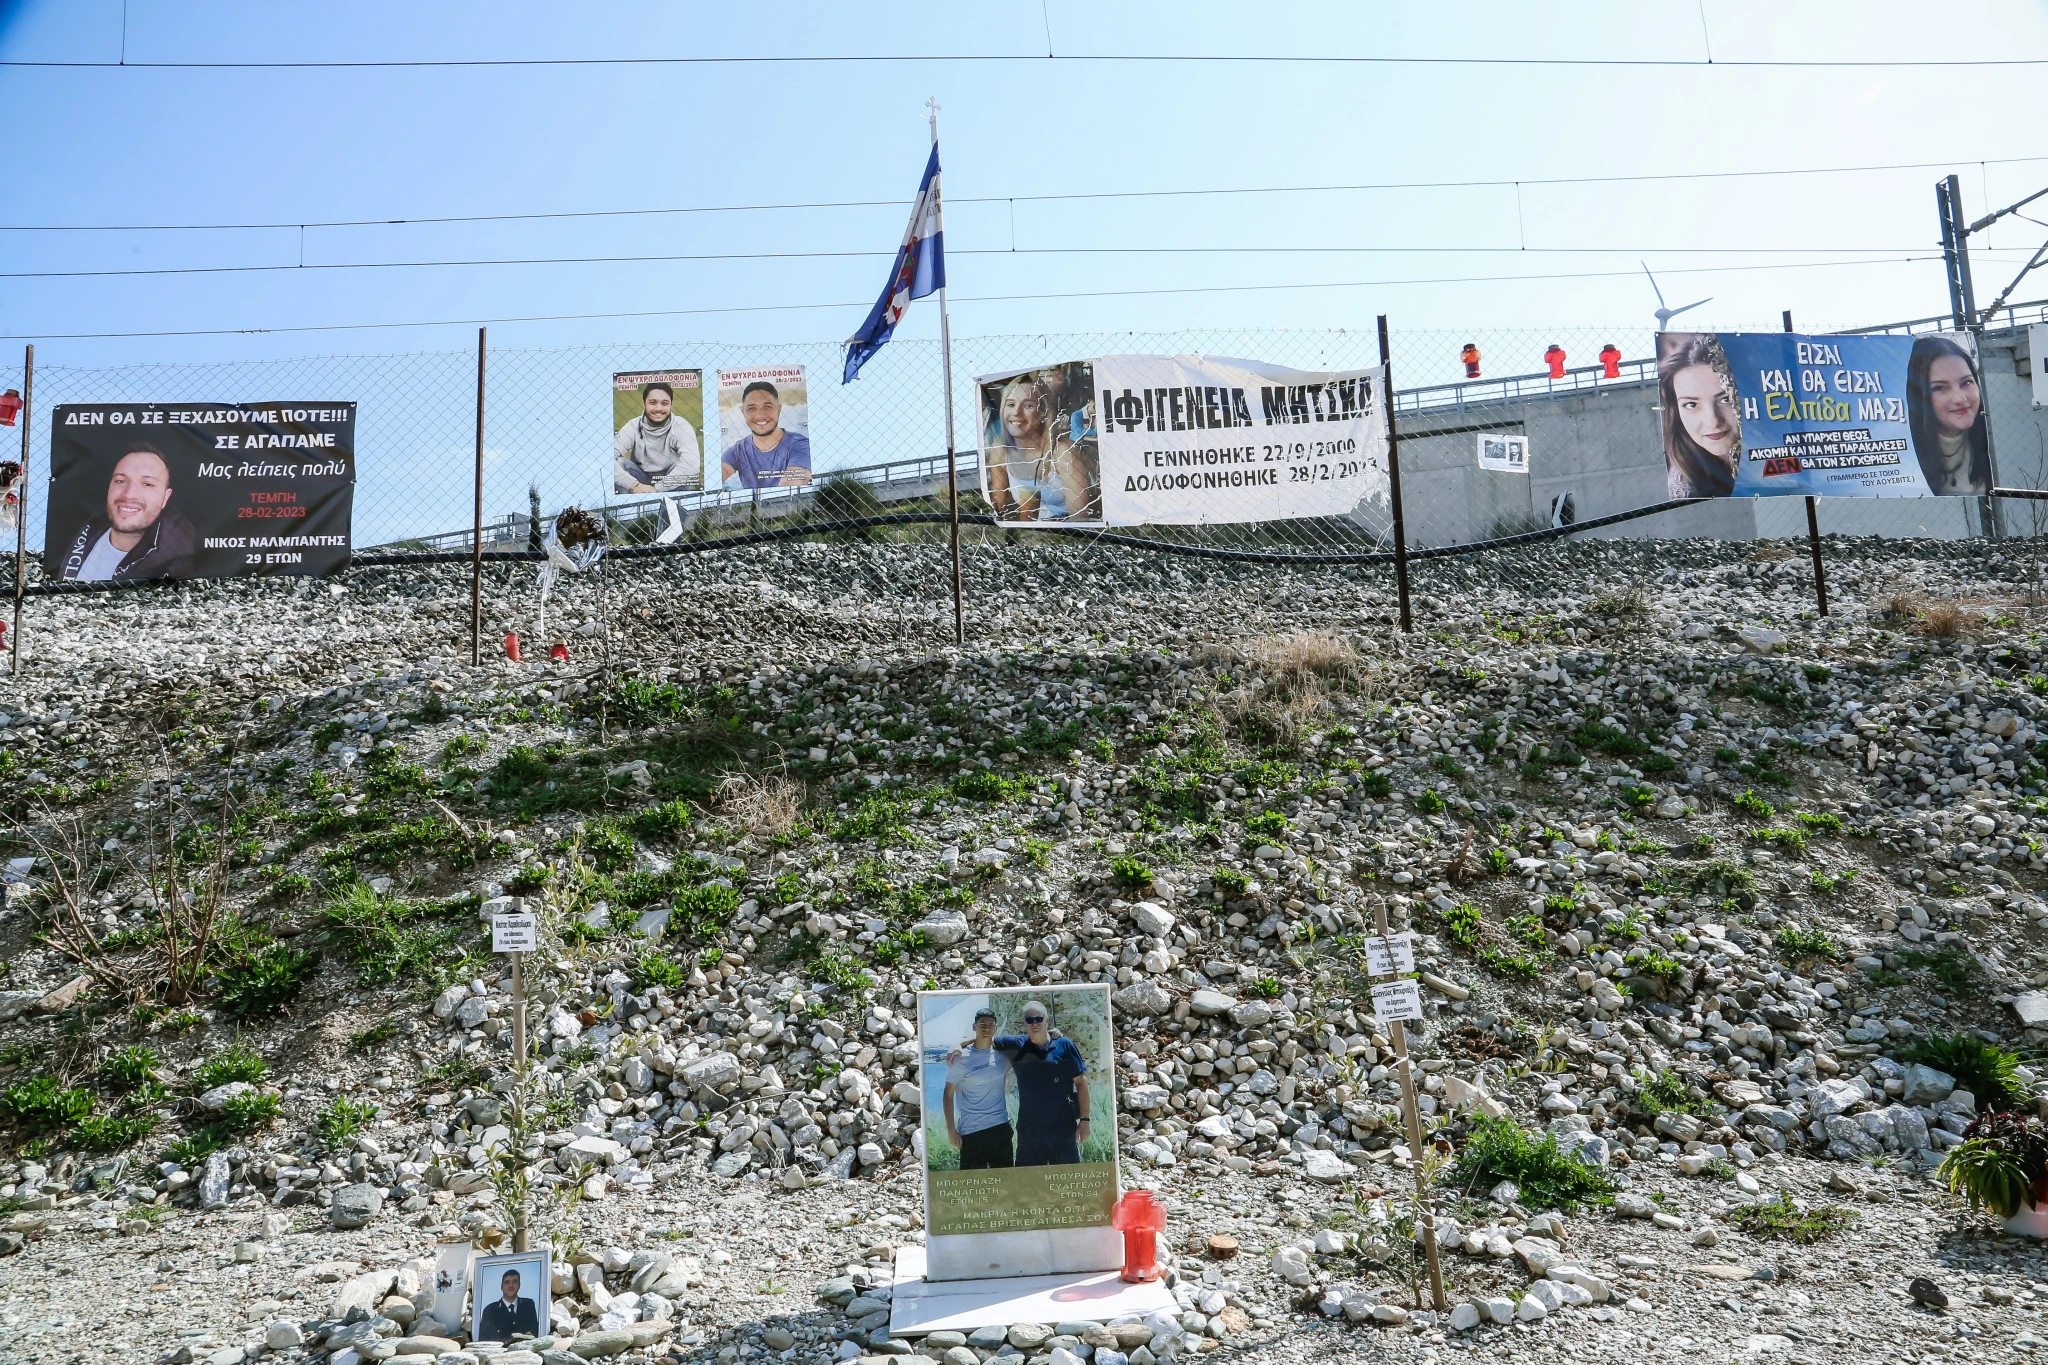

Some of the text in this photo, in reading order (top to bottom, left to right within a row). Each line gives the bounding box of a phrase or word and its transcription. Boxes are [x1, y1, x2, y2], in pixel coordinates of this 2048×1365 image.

[1796, 342, 1843, 365] ΕΙΣΑΙ
[654, 373, 698, 382] ΔΟΛΟΦΟΝΙΑ
[732, 371, 757, 380] ΨΥΧΡΩ
[758, 369, 801, 378] ΔΟΛΟΦΟΝΙΑ
[1760, 369, 1884, 393] ΚΑΙ ΘΑ ΕΙΣΑΙ
[1103, 386, 1253, 433] ΙΦΙΓΕΝΕΙΑ
[1744, 392, 1906, 423] Η Ελπίδα ΜΑΣ!
[65, 409, 348, 425] ΔΕΝ ΘΑ ΣΕ ΞΕΧΑΣΟΥΜΕ ΠΟΤΕ!!!
[214, 433, 336, 449] ΣΕ ΑΓΑΠΑΜΕ
[1785, 430, 1870, 445] ΑΝ ΥΠΑΡΧΕΙ ΘΕΟΣ
[1143, 438, 1356, 467] ΓΕΝΝΗΘΗΚΕ 22/9/2000
[1750, 440, 1906, 460] ΑΚΟΜΗ ΚΑΙ ΝΑ ΜΕ ΠΑΡΑΚΑΛΕΣΕΙ
[197, 459, 346, 480] Μας λείπεις πολύ
[1764, 458, 1801, 475] ΔΕΝ
[1801, 458, 1816, 468] ΘΑ
[1817, 456, 1838, 468] ΤΟΝ
[1124, 468, 1278, 491] ΔΟΛΟΦΟΝΗΘΗΚΕ
[1878, 469, 1900, 478] ΤΟΙΧΟ
[249, 492, 297, 504] ΤΕΜΠΗ
[237, 506, 307, 518] 28-02-2023
[204, 535, 346, 548] ΝΙΚΟΣ ΝΑΛΜΠΑΝΤΗΣ
[245, 552, 302, 564] 29 ΕΤΩΝ
[1044, 1170, 1109, 1181] ΜΠΟΥΡΝΑΖΗ
[936, 1177, 1002, 1188] ΜΠΟΥΡΝΑΖΗ
[1049, 1180, 1108, 1191] ΕΥΑΓΓΕΛΟΥ
[939, 1187, 999, 1197] ΠΑΝΑΓΙΩΤΗ
[1060, 1191, 1084, 1199] ΕΤΩΝ
[950, 1197, 974, 1205] ΕΤΩΝ
[963, 1209, 1007, 1219] ΜΑΚΡΙΑ
[1022, 1206, 1060, 1216] ΚΟΝΤΑ
[939, 1213, 1111, 1231] ΑΓΑΠΑΣ ΒΡΙΣΚΕΤΑΙ ΜΕΣΑ ΣΟΥ
